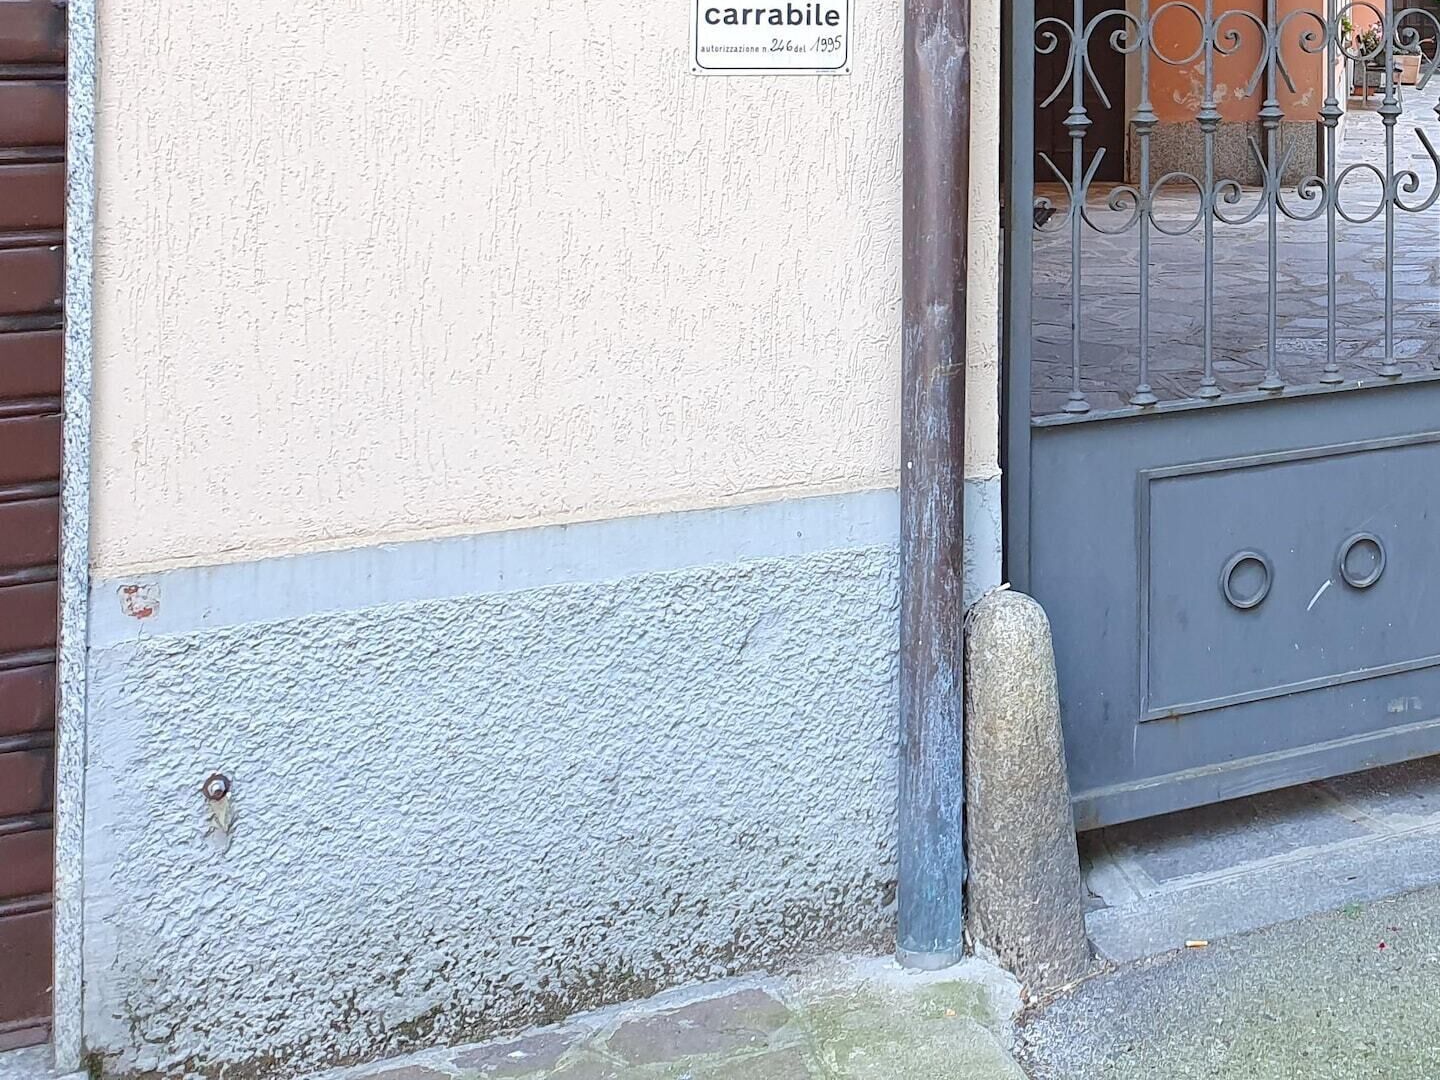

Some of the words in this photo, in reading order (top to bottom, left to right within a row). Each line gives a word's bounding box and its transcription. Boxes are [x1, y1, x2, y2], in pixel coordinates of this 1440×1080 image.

[705, 3, 840, 26] carrabile
[701, 44, 759, 53] autorizzazione
[794, 45, 806, 53] del
[810, 35, 842, 53] 1995
